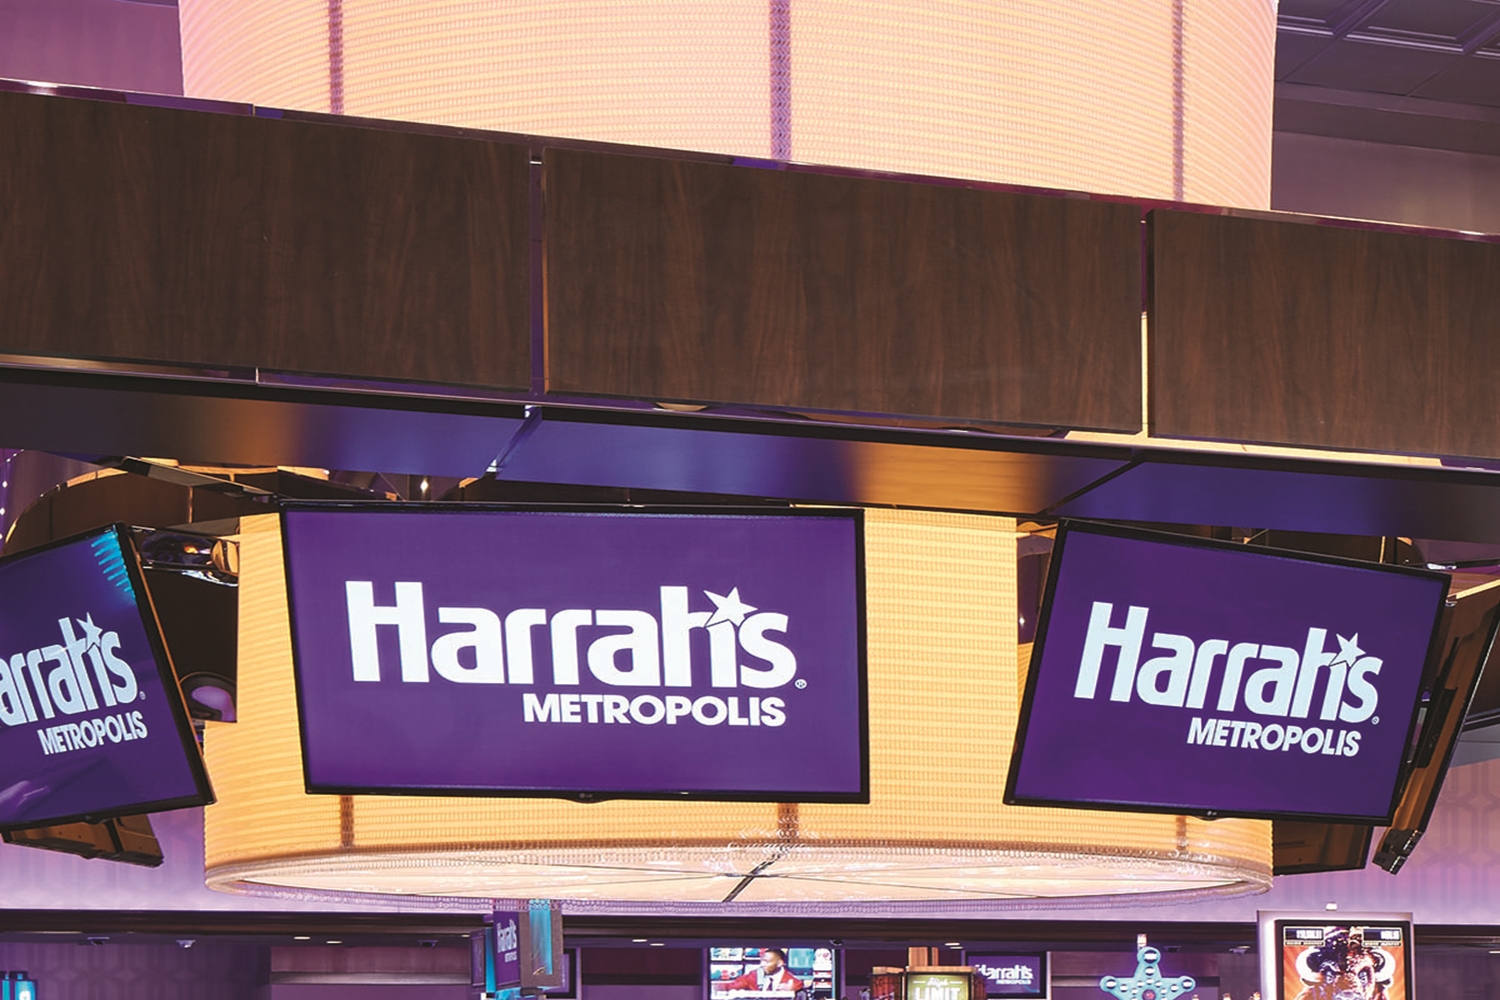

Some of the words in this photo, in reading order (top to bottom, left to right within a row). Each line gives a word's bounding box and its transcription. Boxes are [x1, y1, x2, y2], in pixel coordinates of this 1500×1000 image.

[0, 612, 138, 726] arrah's
[522, 693, 787, 727] METROPOLIS
[37, 710, 148, 755] METROPOLIS
[1186, 718, 1362, 757] METROPOLIS
